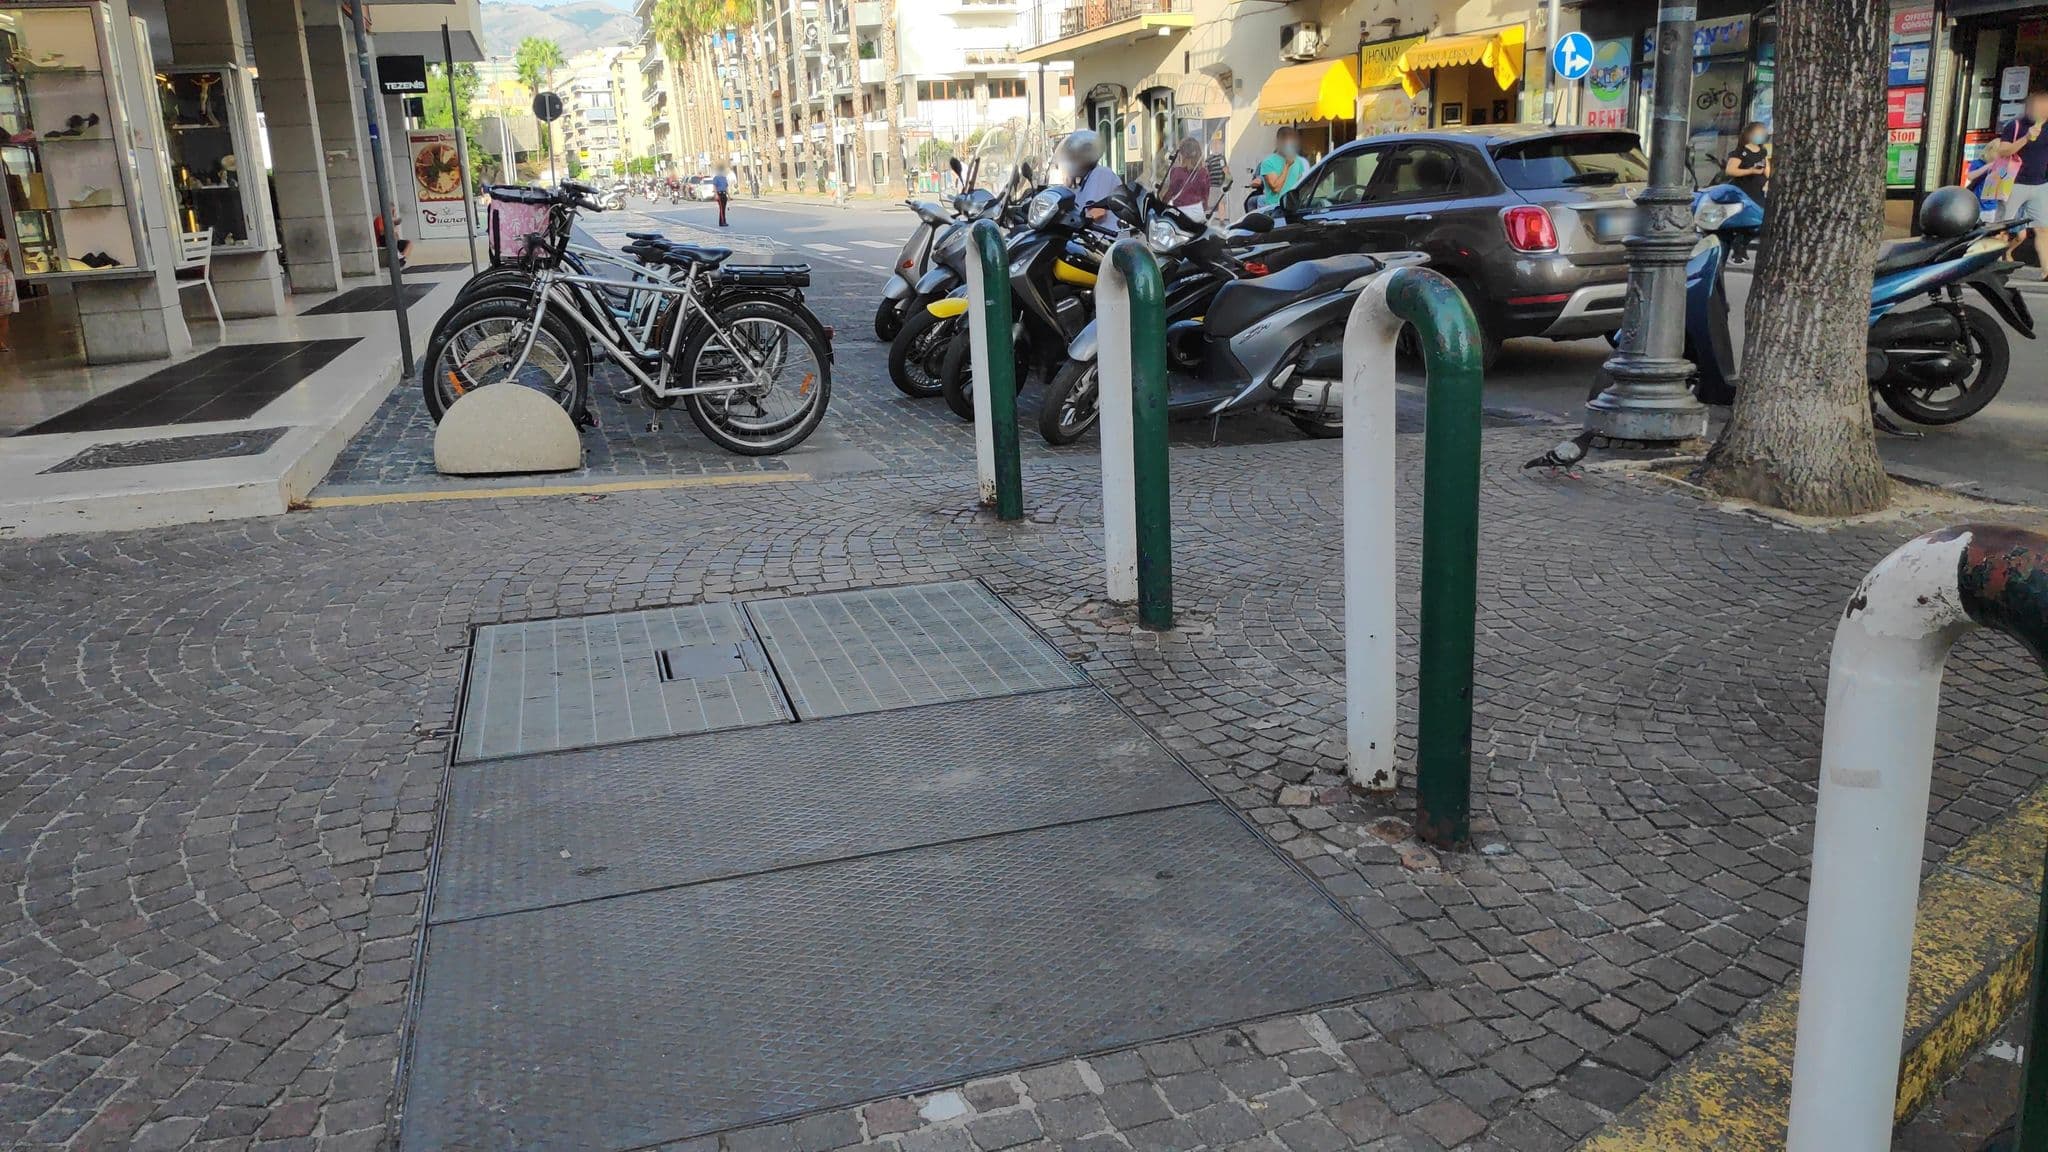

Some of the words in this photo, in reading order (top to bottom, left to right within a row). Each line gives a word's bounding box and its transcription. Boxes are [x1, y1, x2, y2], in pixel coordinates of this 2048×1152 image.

[385, 80, 425, 90] TEZENIS
[1588, 108, 1627, 128] RENT
[1890, 131, 1916, 142] Stop
